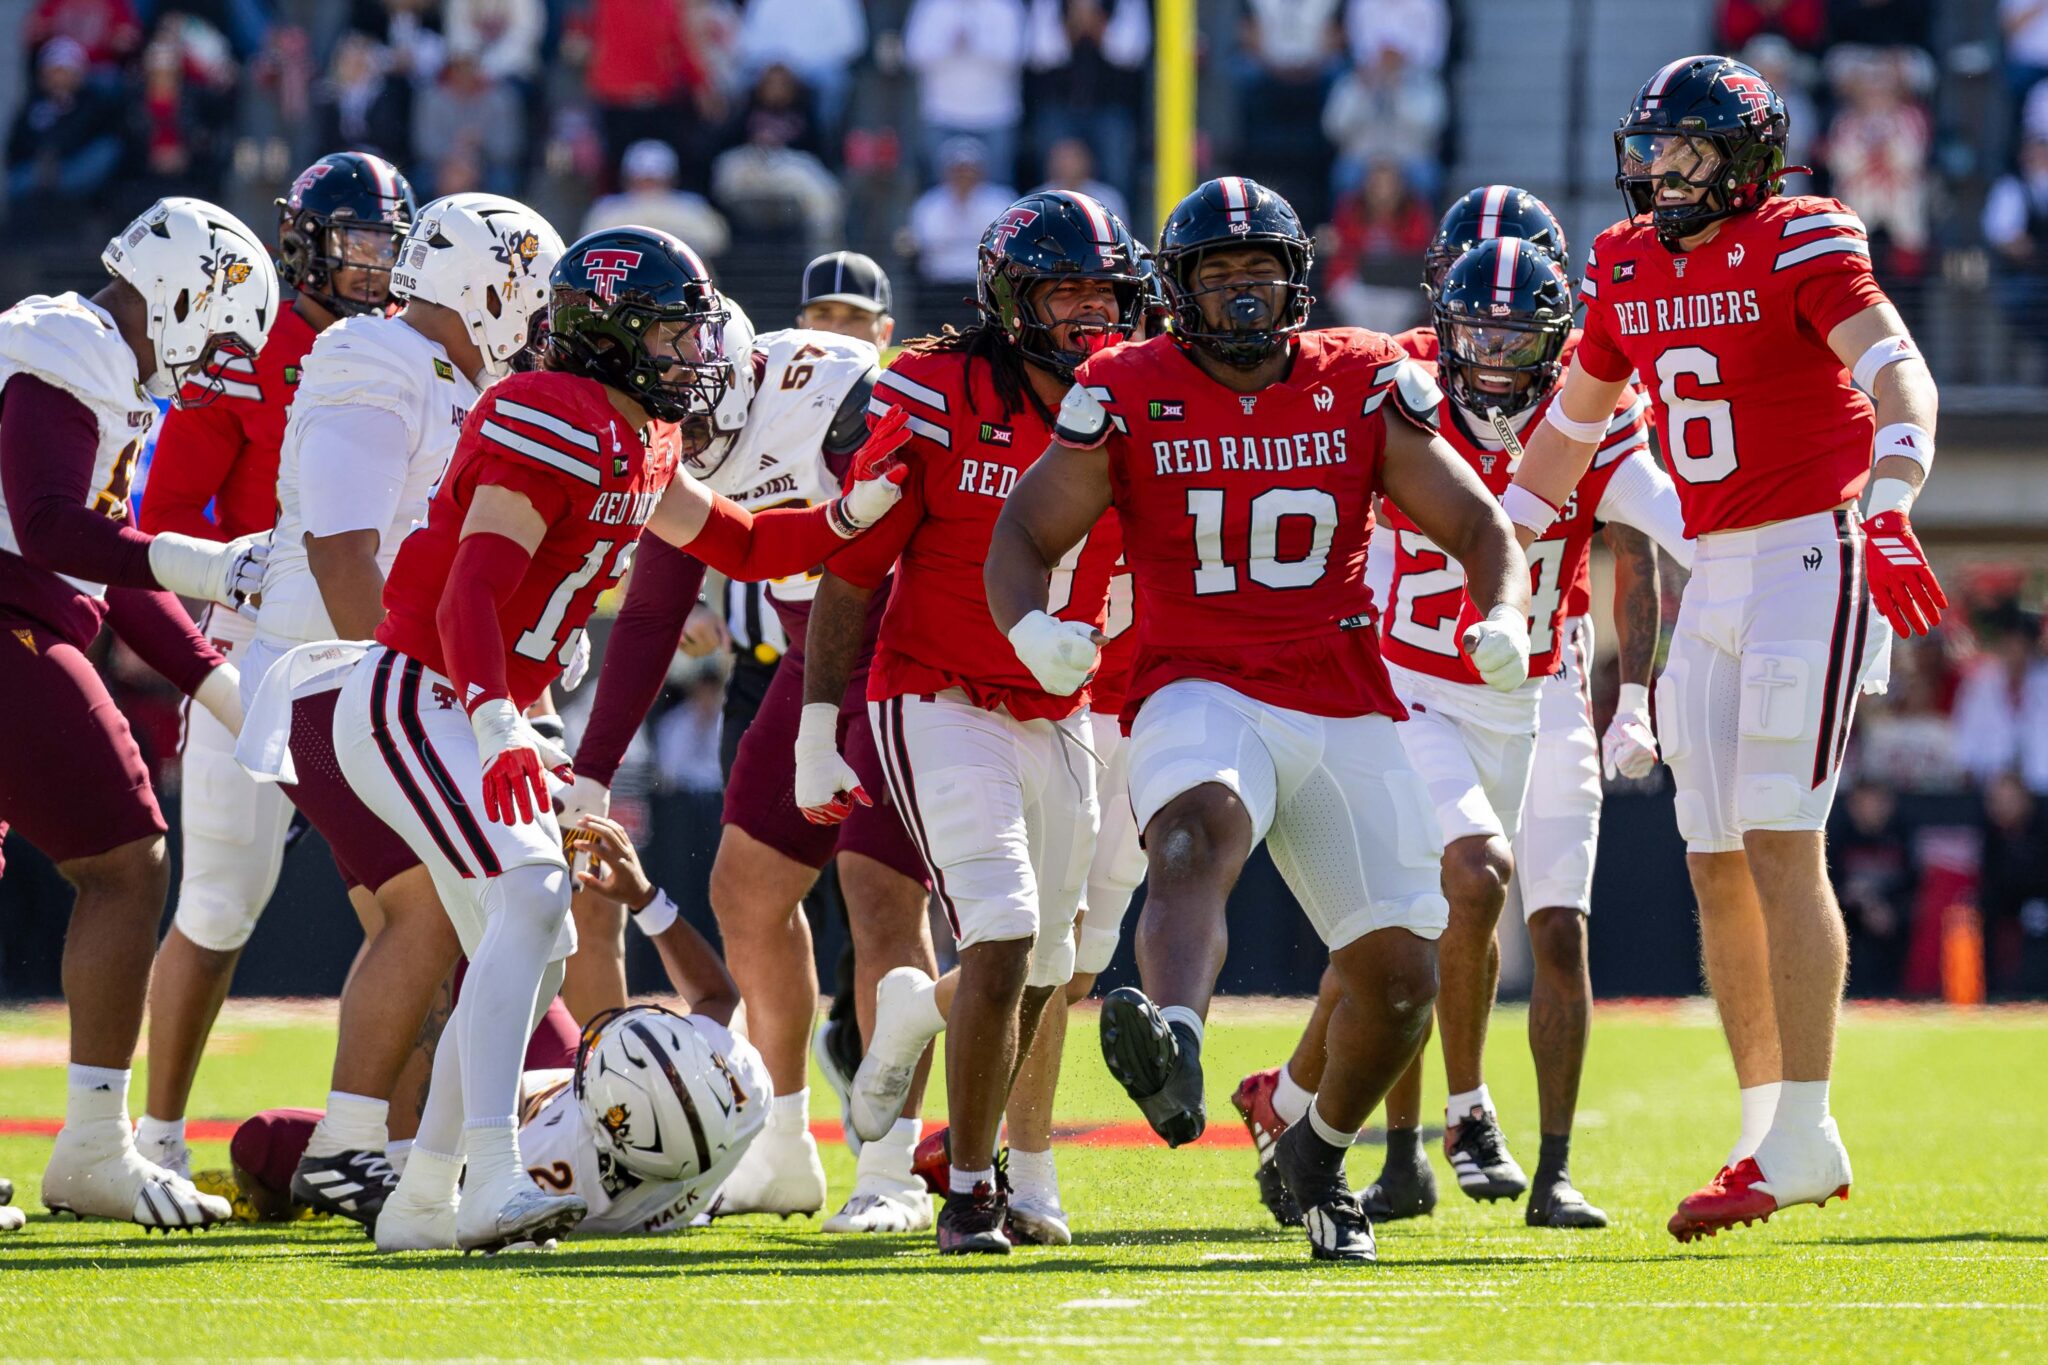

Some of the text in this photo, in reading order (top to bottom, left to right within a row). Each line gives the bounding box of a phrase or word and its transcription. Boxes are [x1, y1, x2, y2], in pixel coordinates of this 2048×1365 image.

[1228, 220, 1251, 235] Tech
[392, 272, 417, 291] DEVILS
[1489, 303, 1511, 317] Tech
[1613, 289, 1761, 336] RED RAIDERS
[779, 342, 829, 392] 57
[1496, 419, 1520, 454] BATTLE
[1654, 346, 1740, 485] 6
[1151, 428, 1348, 476] RED RAIDERS
[753, 473, 799, 499] STATE
[958, 458, 1018, 499] RED
[588, 492, 632, 525] RED
[1186, 486, 1340, 595] 10
[1388, 529, 1568, 658] 24
[644, 1187, 700, 1232] MACK
